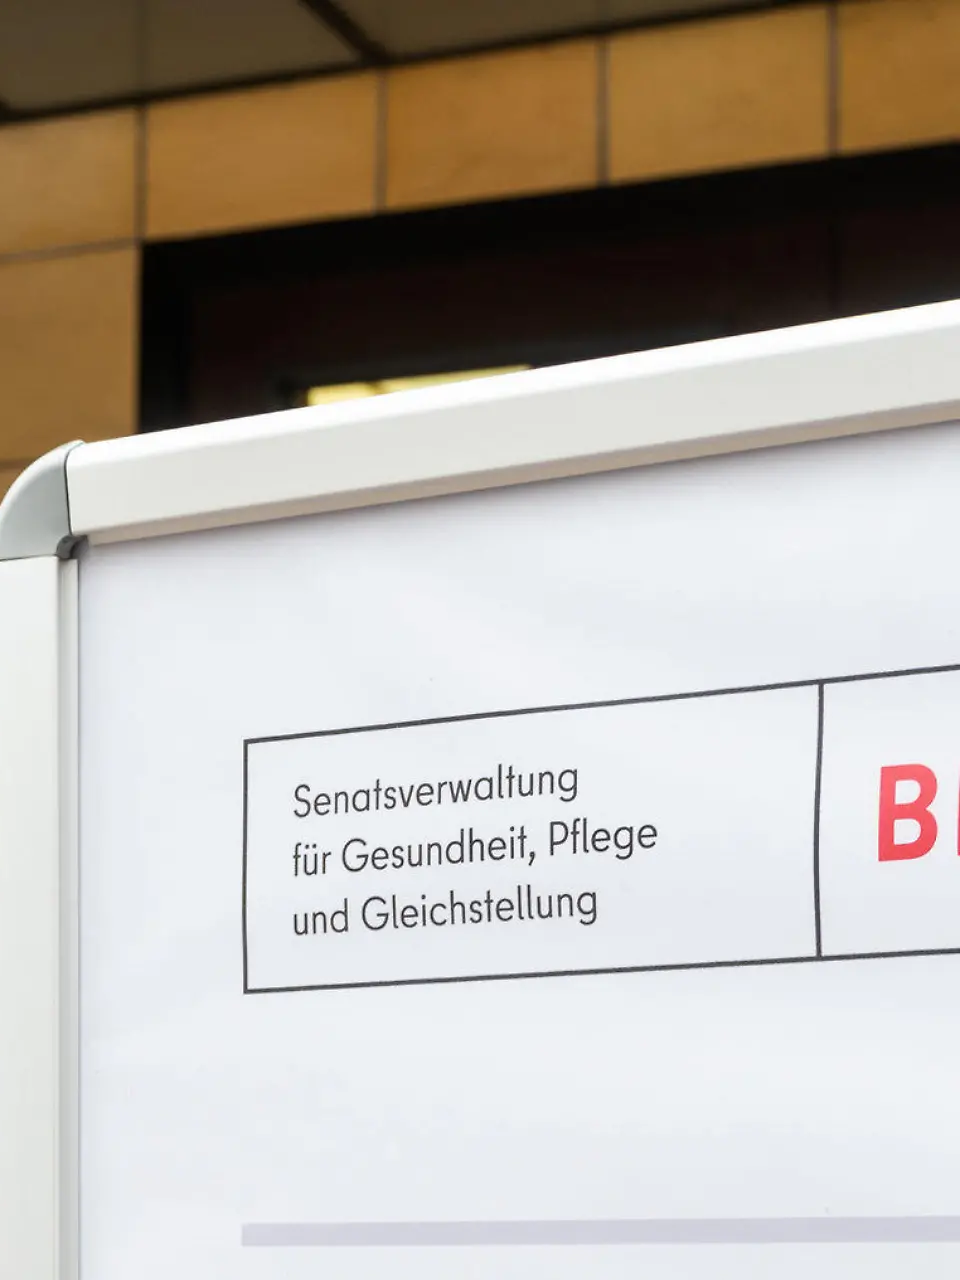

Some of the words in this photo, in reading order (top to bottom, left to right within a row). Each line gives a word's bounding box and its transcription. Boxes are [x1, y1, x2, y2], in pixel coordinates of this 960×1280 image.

[292, 763, 580, 819] Senatsverwaltung
[877, 762, 960, 863] B
[292, 841, 332, 877] für
[341, 825, 537, 873] Gesundheit,
[549, 817, 659, 861] Pflege
[292, 897, 349, 936] und
[361, 883, 598, 932] Gleichstellung
